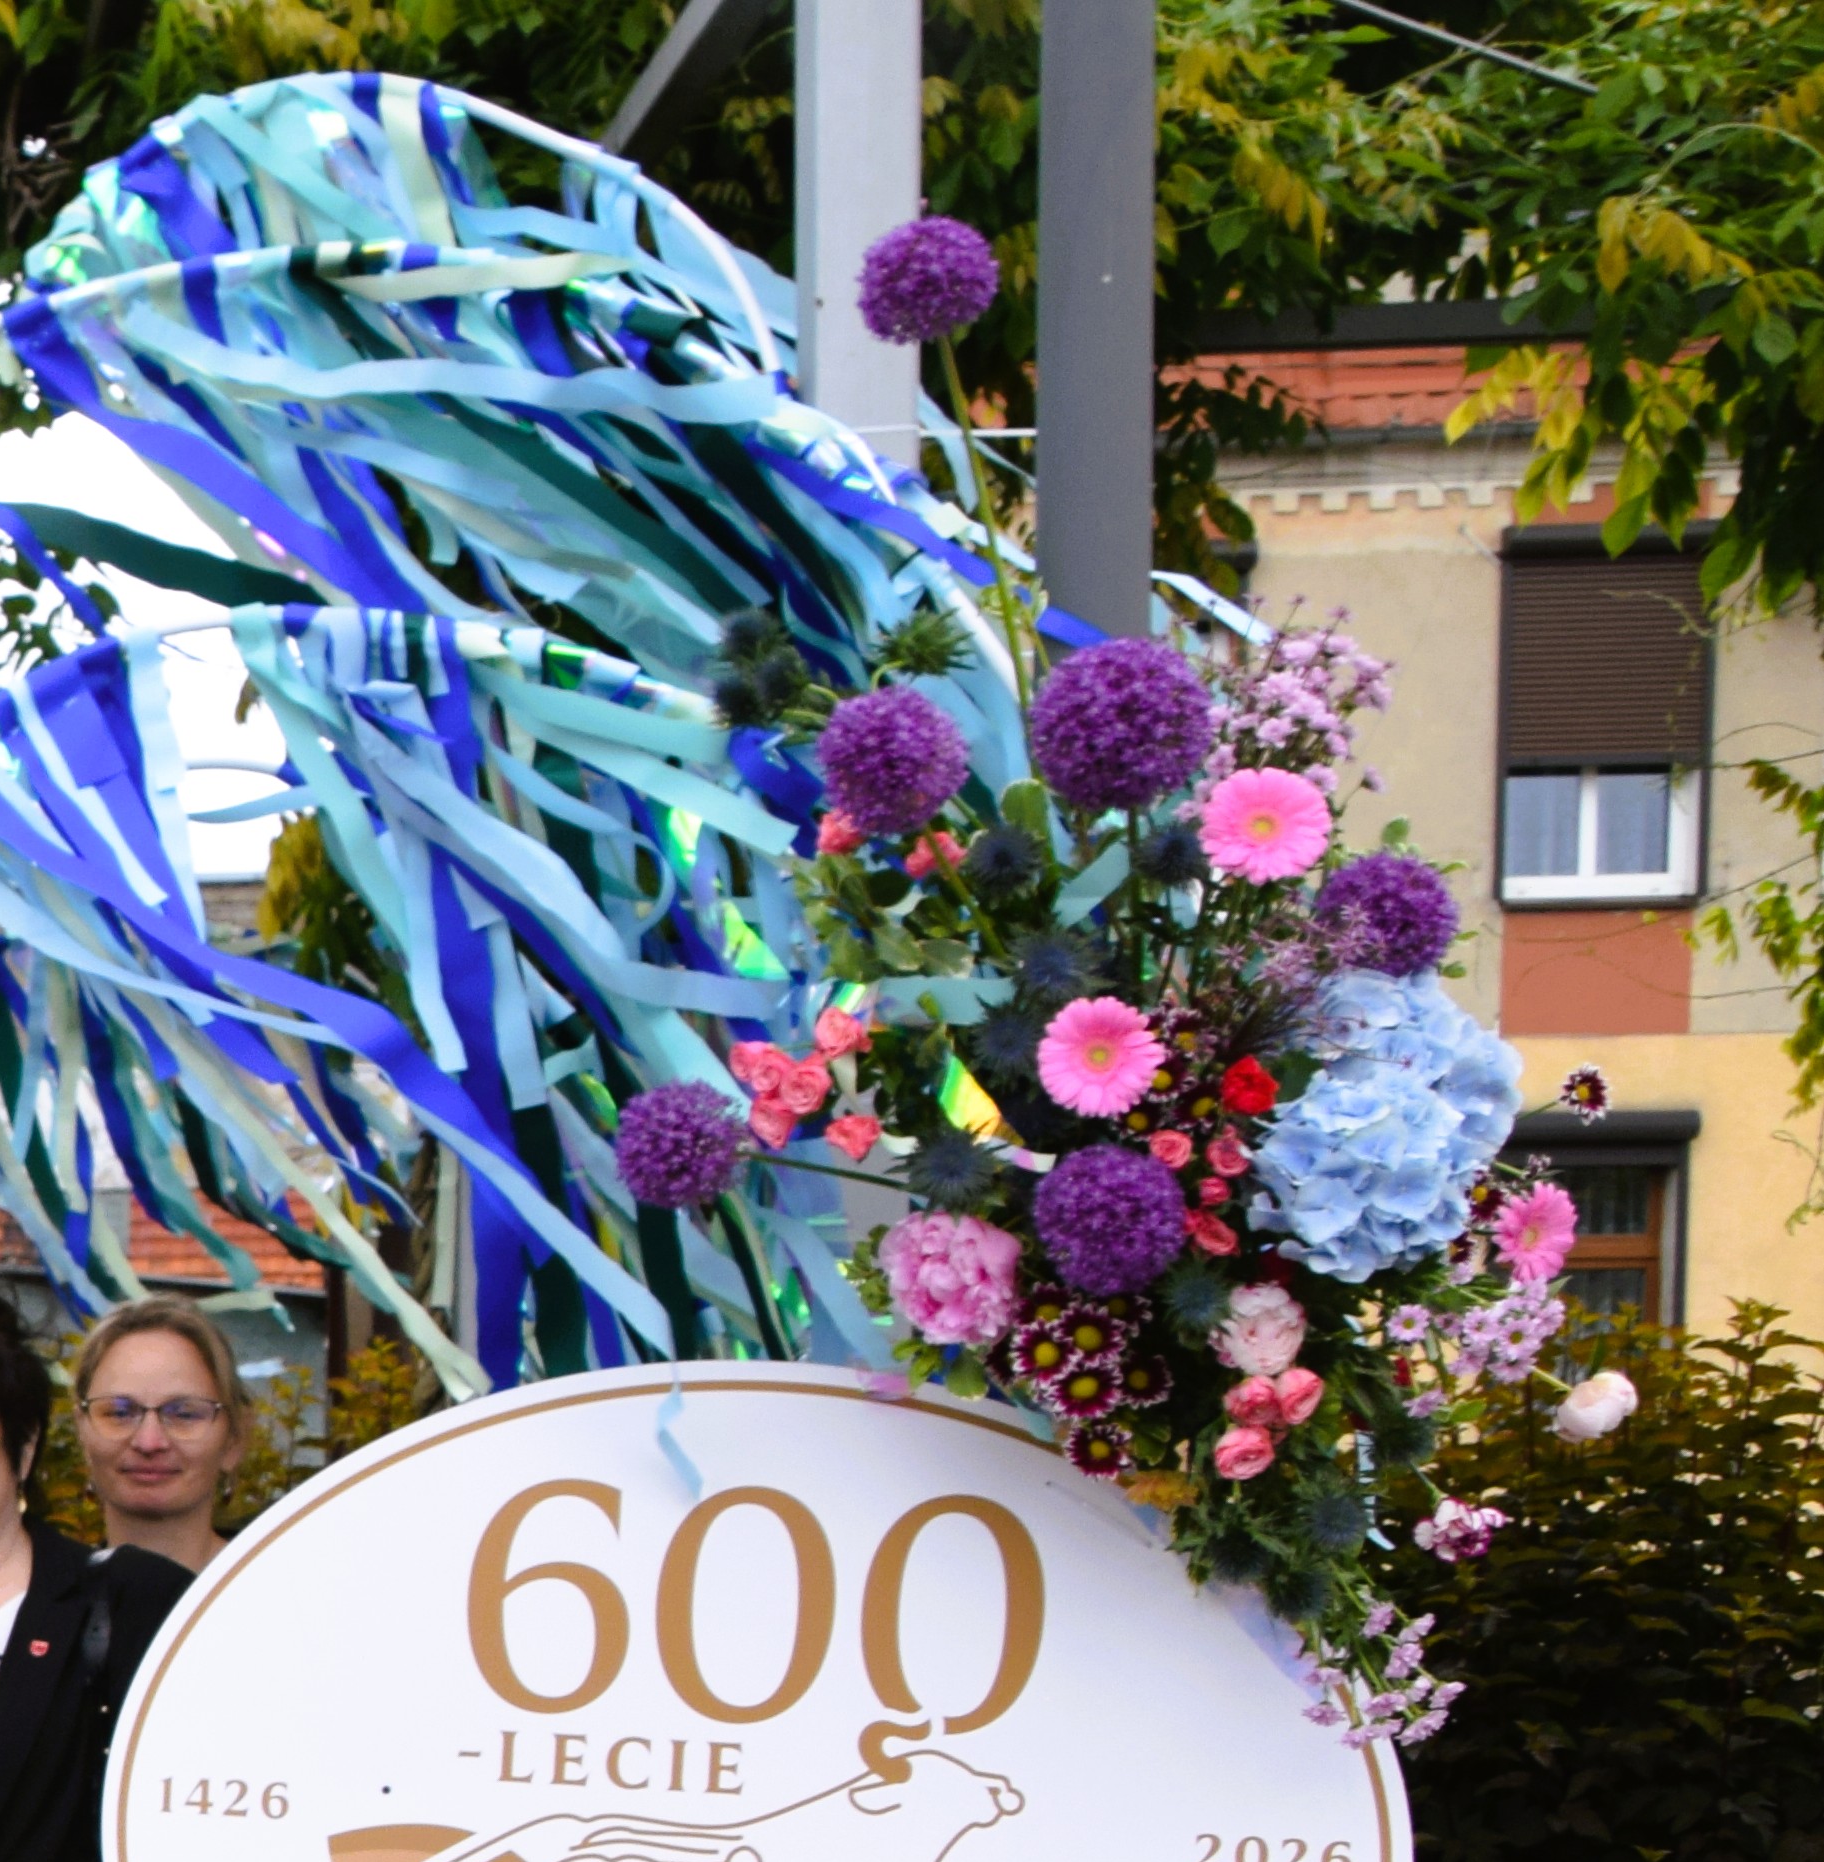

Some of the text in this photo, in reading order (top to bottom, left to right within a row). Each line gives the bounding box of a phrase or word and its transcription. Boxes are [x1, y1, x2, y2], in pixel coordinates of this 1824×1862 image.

[466, 1478, 1045, 1736] 600
[456, 1731, 744, 1796] -LECIE
[158, 1777, 289, 1821] 1426
